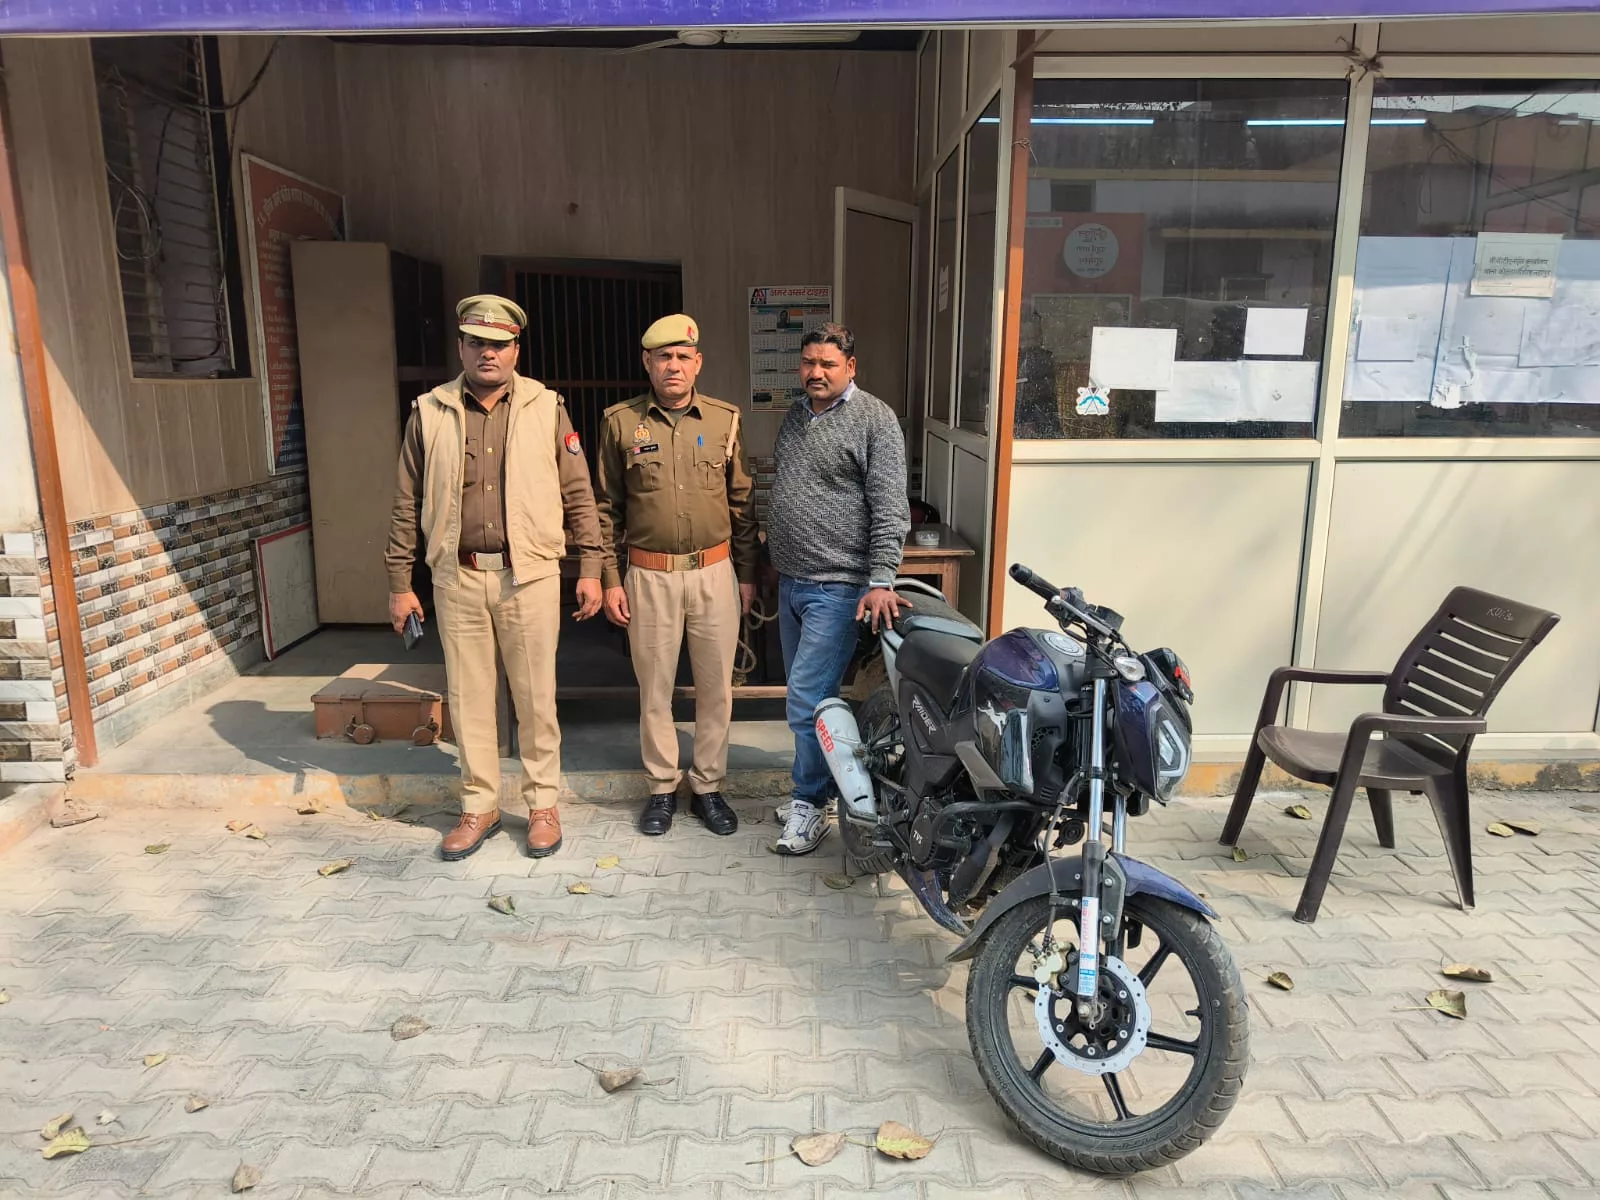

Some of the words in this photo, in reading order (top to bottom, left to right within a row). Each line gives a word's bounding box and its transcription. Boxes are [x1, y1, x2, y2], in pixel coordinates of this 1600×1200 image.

[912, 694, 936, 735] RAIDER
[815, 718, 835, 753] SPEED
[912, 830, 923, 845] TVS
